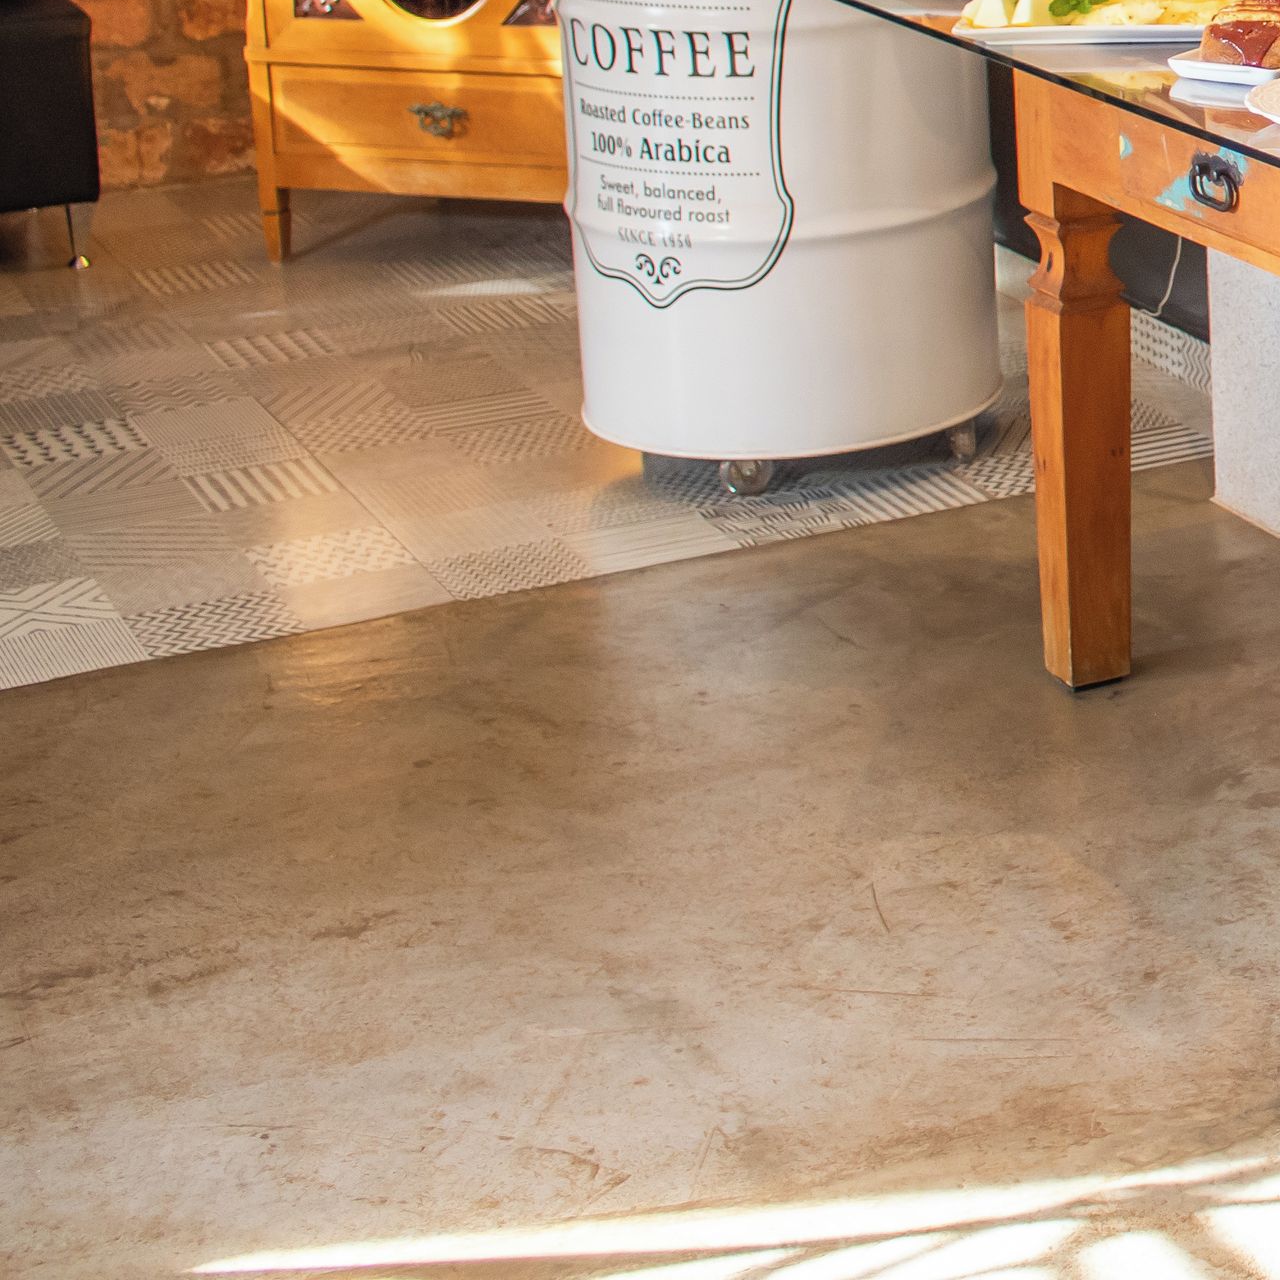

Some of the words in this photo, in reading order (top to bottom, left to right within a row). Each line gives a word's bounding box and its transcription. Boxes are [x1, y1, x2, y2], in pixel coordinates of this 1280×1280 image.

[570, 17, 755, 78] COFFEE
[580, 98, 626, 123] Roasted
[591, 132, 632, 158] 100%
[639, 137, 731, 163] Arabica
[600, 174, 639, 199] Sweet,
[643, 181, 722, 204] balanced,
[597, 194, 614, 212] full
[617, 197, 682, 221] flavoured
[688, 209, 730, 223] roast
[618, 226, 656, 246] SINCE
